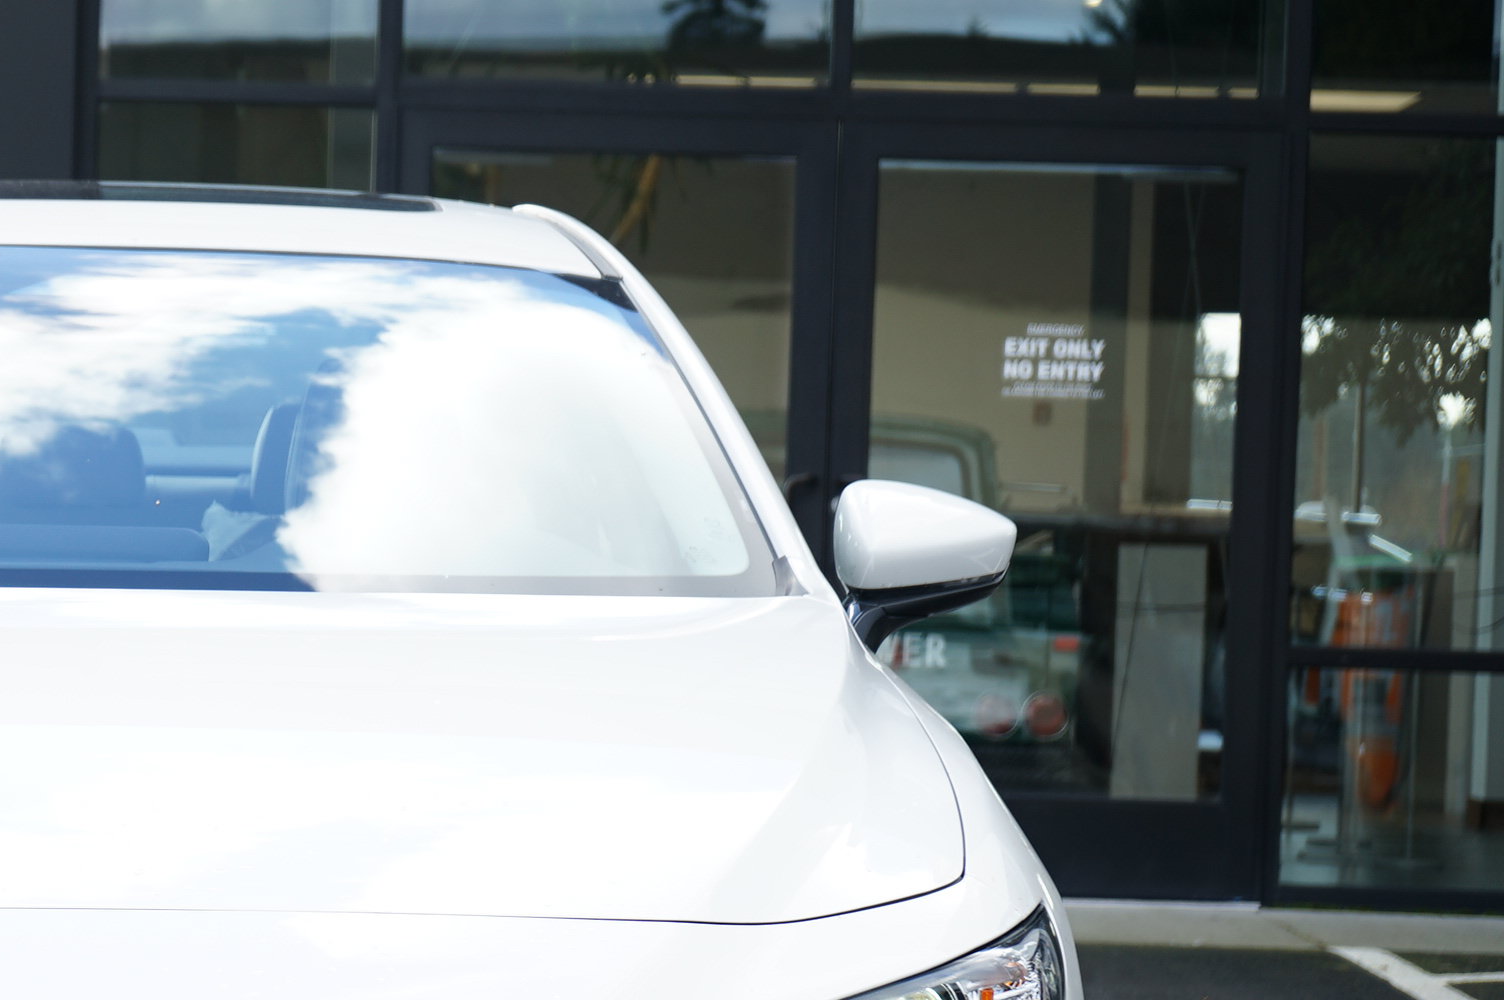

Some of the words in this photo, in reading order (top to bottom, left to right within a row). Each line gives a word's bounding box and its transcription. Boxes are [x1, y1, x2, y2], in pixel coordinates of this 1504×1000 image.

[1004, 336, 1049, 358] EXIT
[1053, 338, 1106, 360] ONLY
[1003, 358, 1034, 380] NO
[1037, 360, 1105, 382] ENTRY
